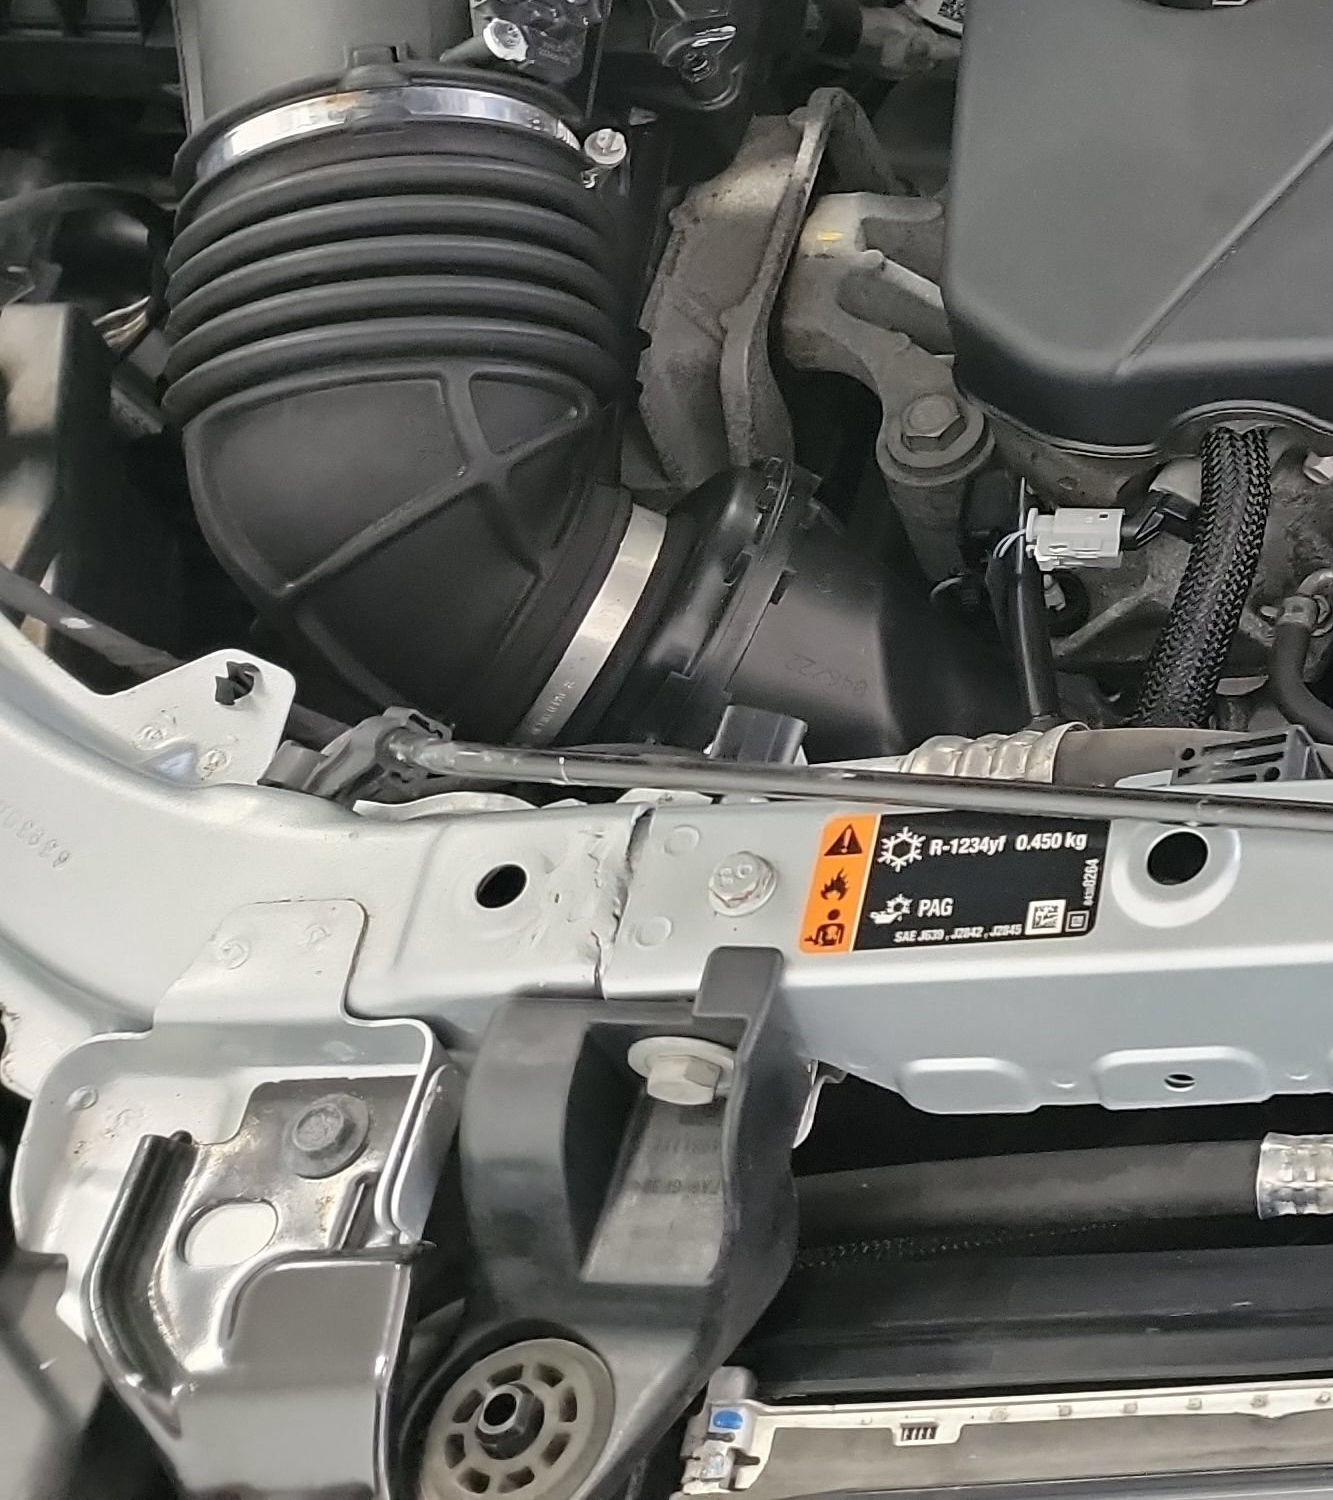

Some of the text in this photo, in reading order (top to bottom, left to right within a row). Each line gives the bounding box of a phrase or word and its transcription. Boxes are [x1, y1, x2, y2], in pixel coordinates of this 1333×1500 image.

[929, 832, 1088, 857] R-1234yf 0.450 kg
[917, 898, 954, 918] PAG
[894, 930, 917, 944] SAE
